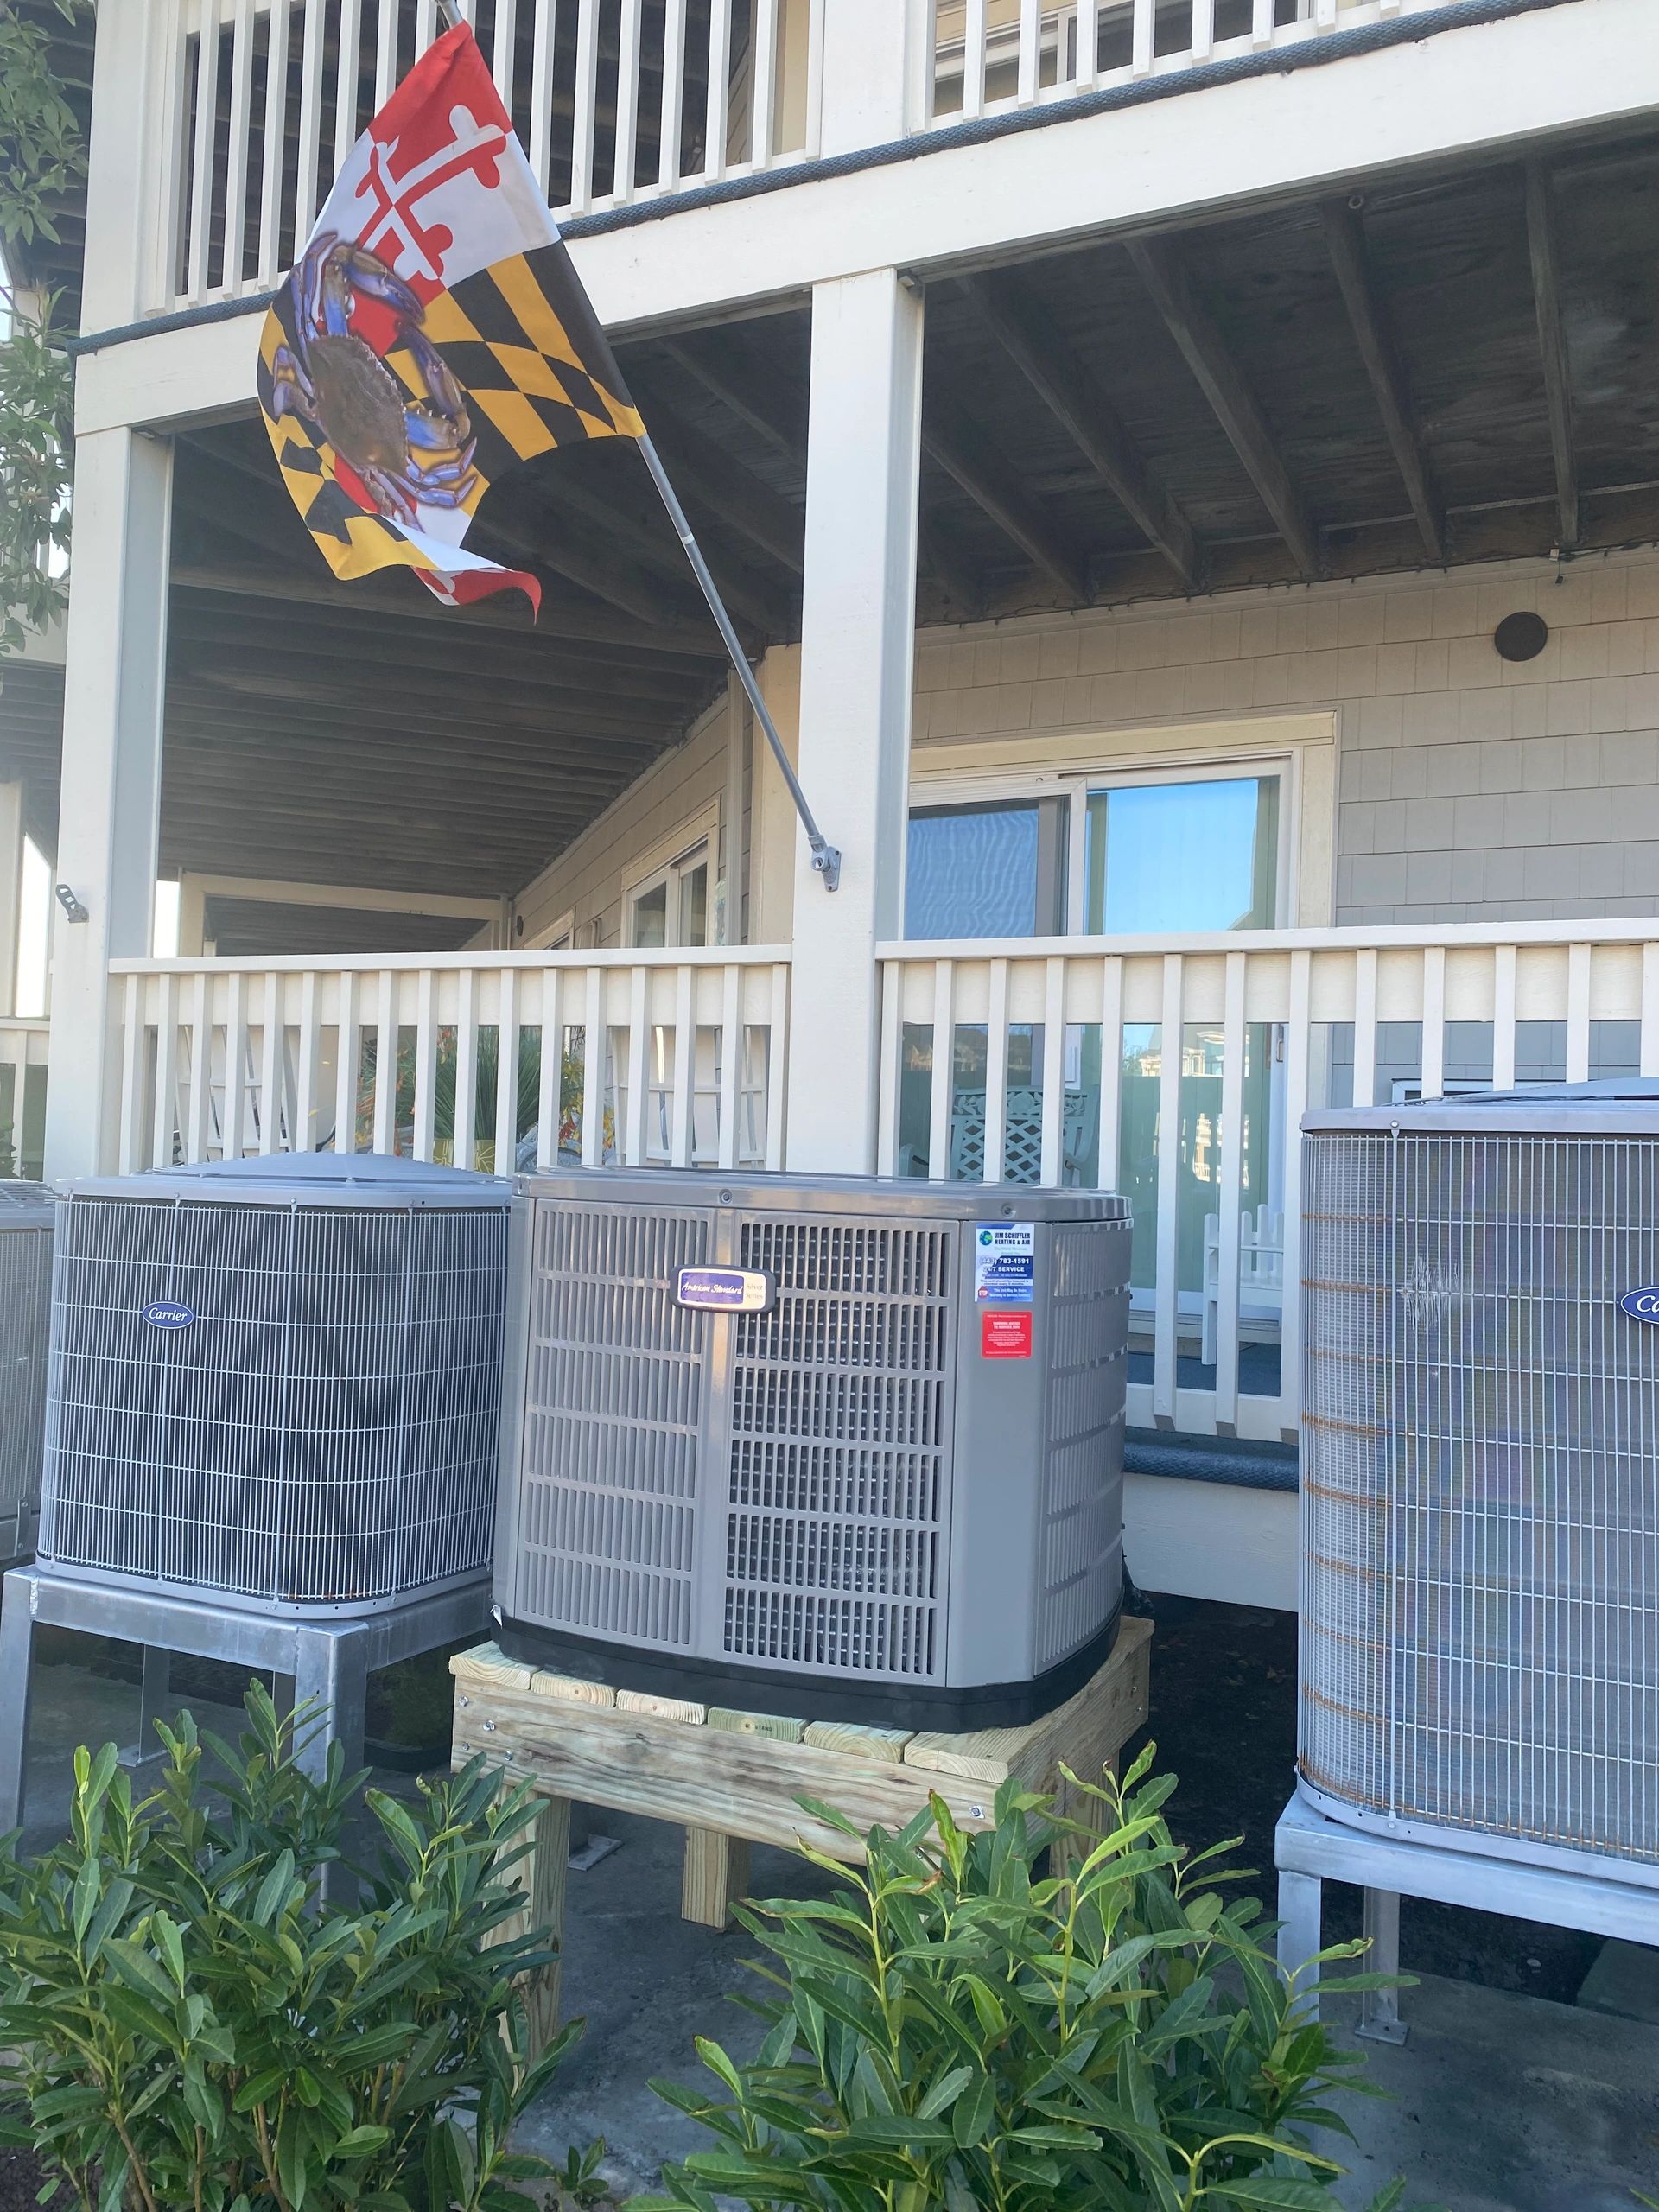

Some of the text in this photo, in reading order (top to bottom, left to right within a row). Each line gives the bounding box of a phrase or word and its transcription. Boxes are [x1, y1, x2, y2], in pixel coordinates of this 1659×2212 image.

[682, 1282, 743, 1294] American Standard
[149, 1307, 188, 1321] Carrier
